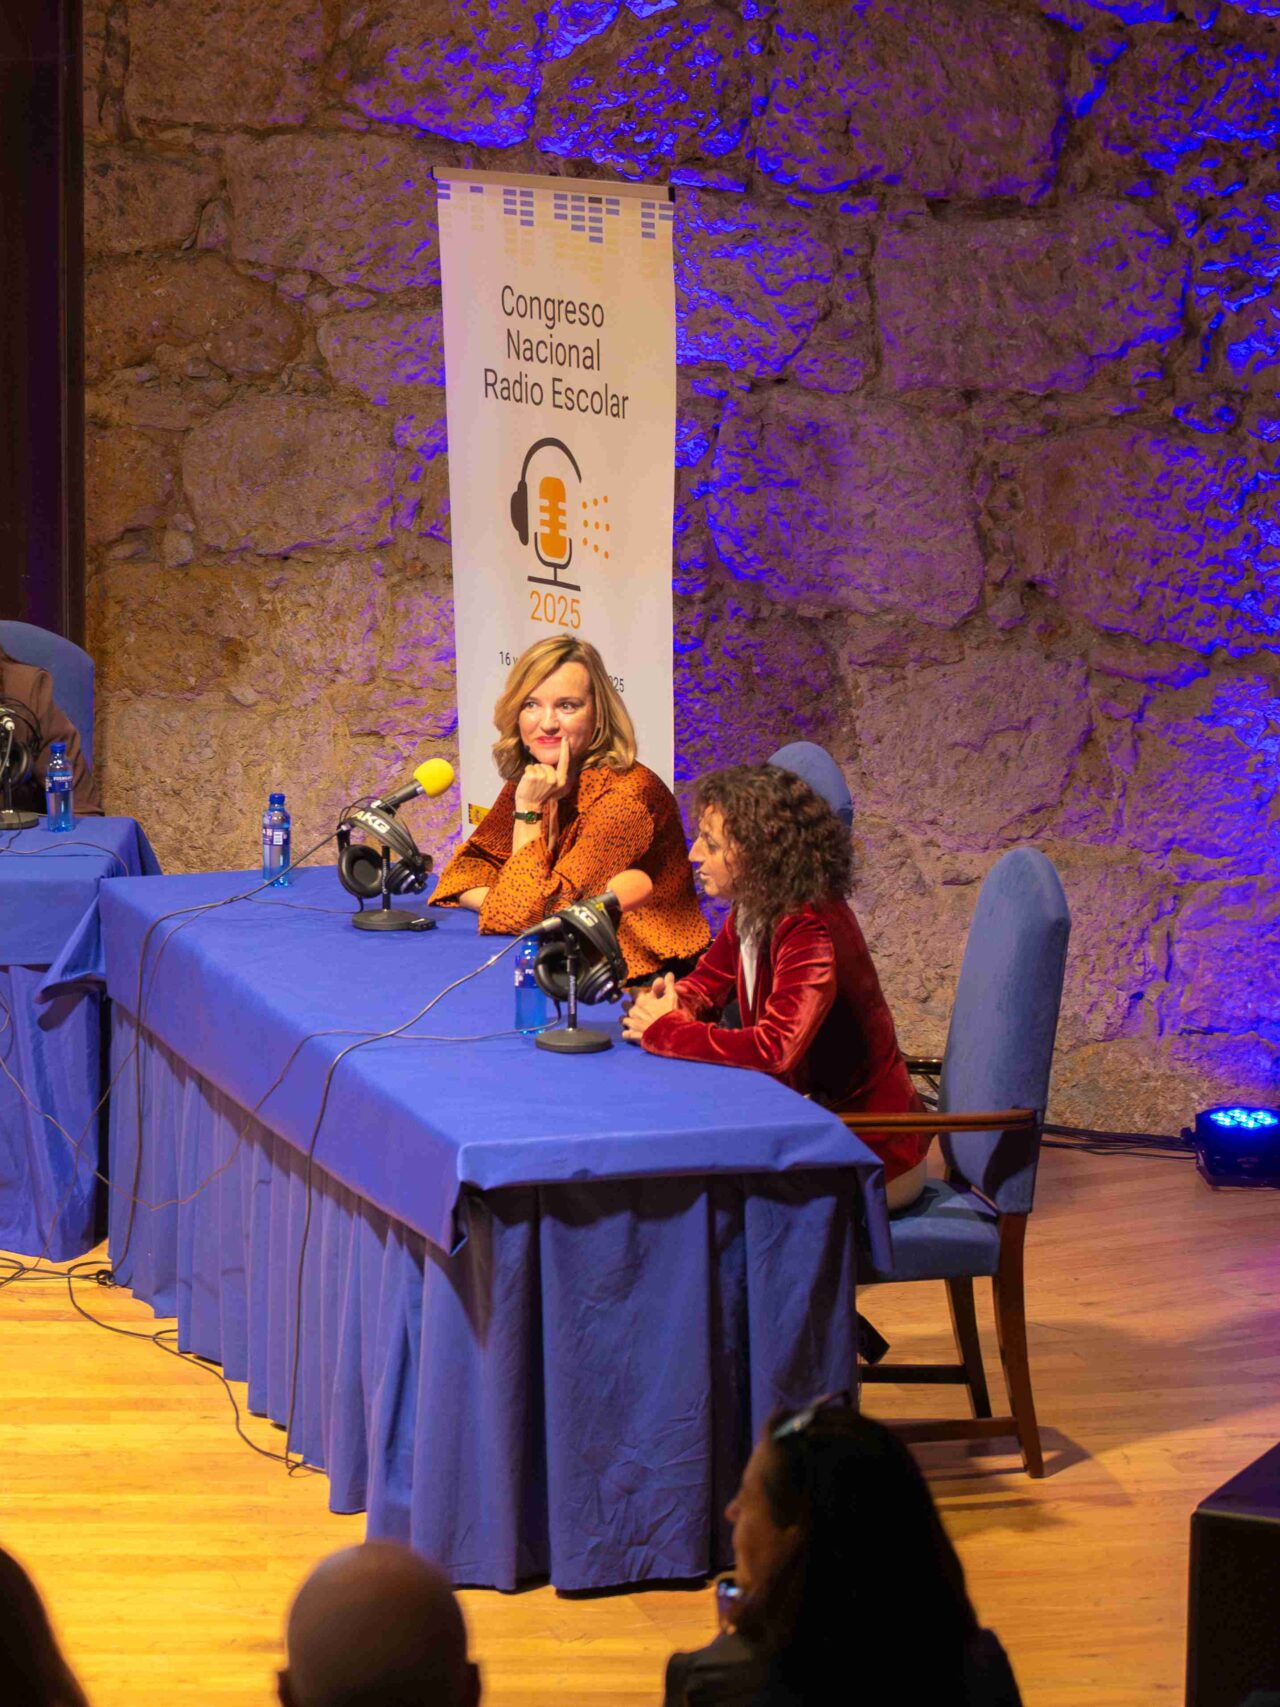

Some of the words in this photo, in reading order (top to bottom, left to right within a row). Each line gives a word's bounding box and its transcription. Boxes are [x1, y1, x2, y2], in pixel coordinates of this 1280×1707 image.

[501, 285, 605, 329] Congreso
[506, 328, 601, 371] Nacional
[484, 368, 543, 406] Radio
[552, 377, 629, 419] Escolar
[530, 590, 581, 629] 2025
[499, 651, 511, 666] 16
[351, 810, 390, 834] AKG
